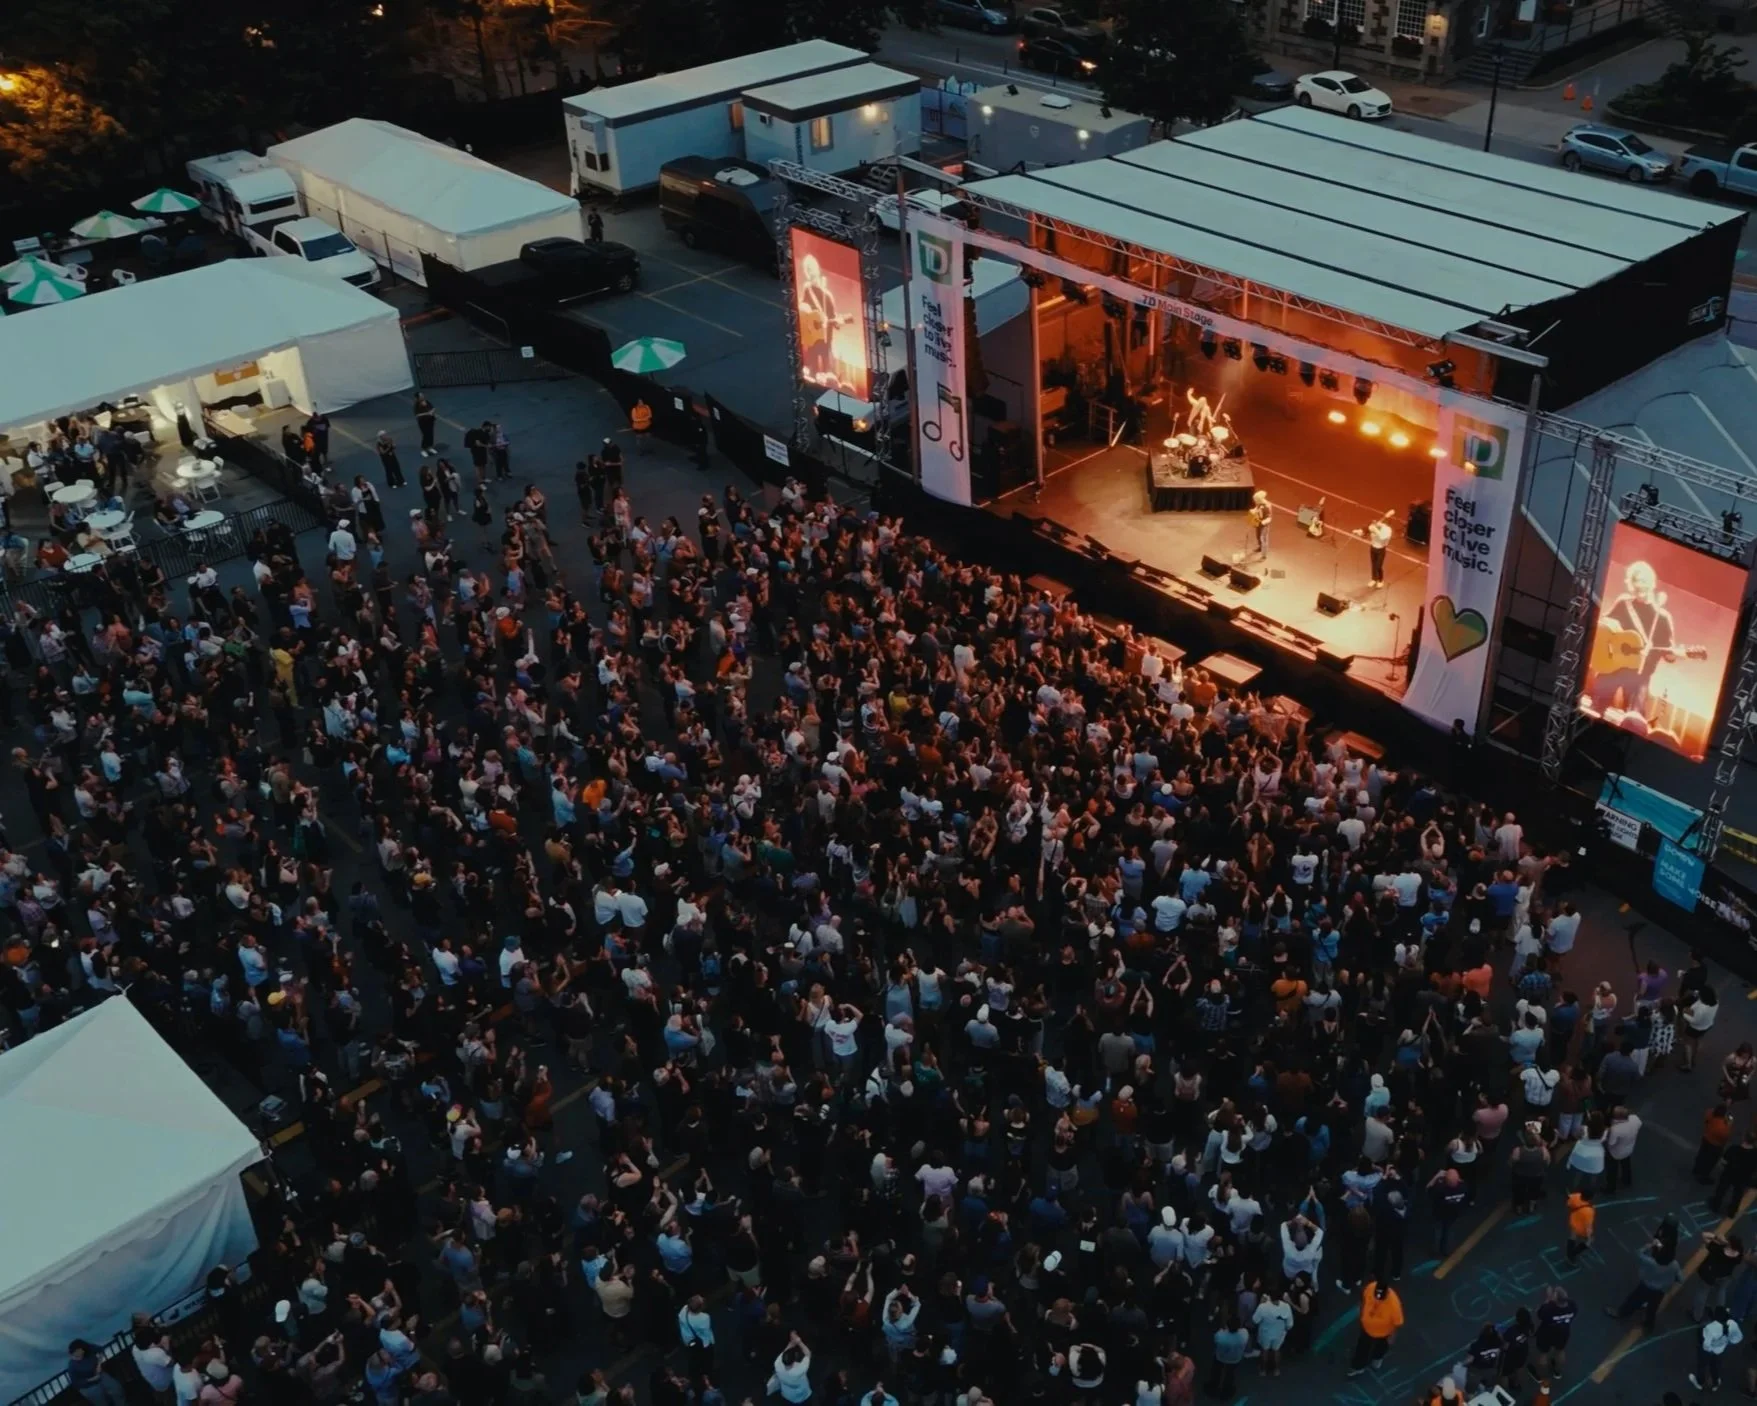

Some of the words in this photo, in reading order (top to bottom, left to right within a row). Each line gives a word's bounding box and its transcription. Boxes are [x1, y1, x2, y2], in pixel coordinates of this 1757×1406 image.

[922, 294, 942, 317] Feel
[1158, 299, 1182, 316] Main
[1183, 307, 1213, 327] Stage
[1445, 488, 1477, 517] Feel
[1443, 509, 1496, 539] closer
[1603, 810, 1638, 831] ARNING
